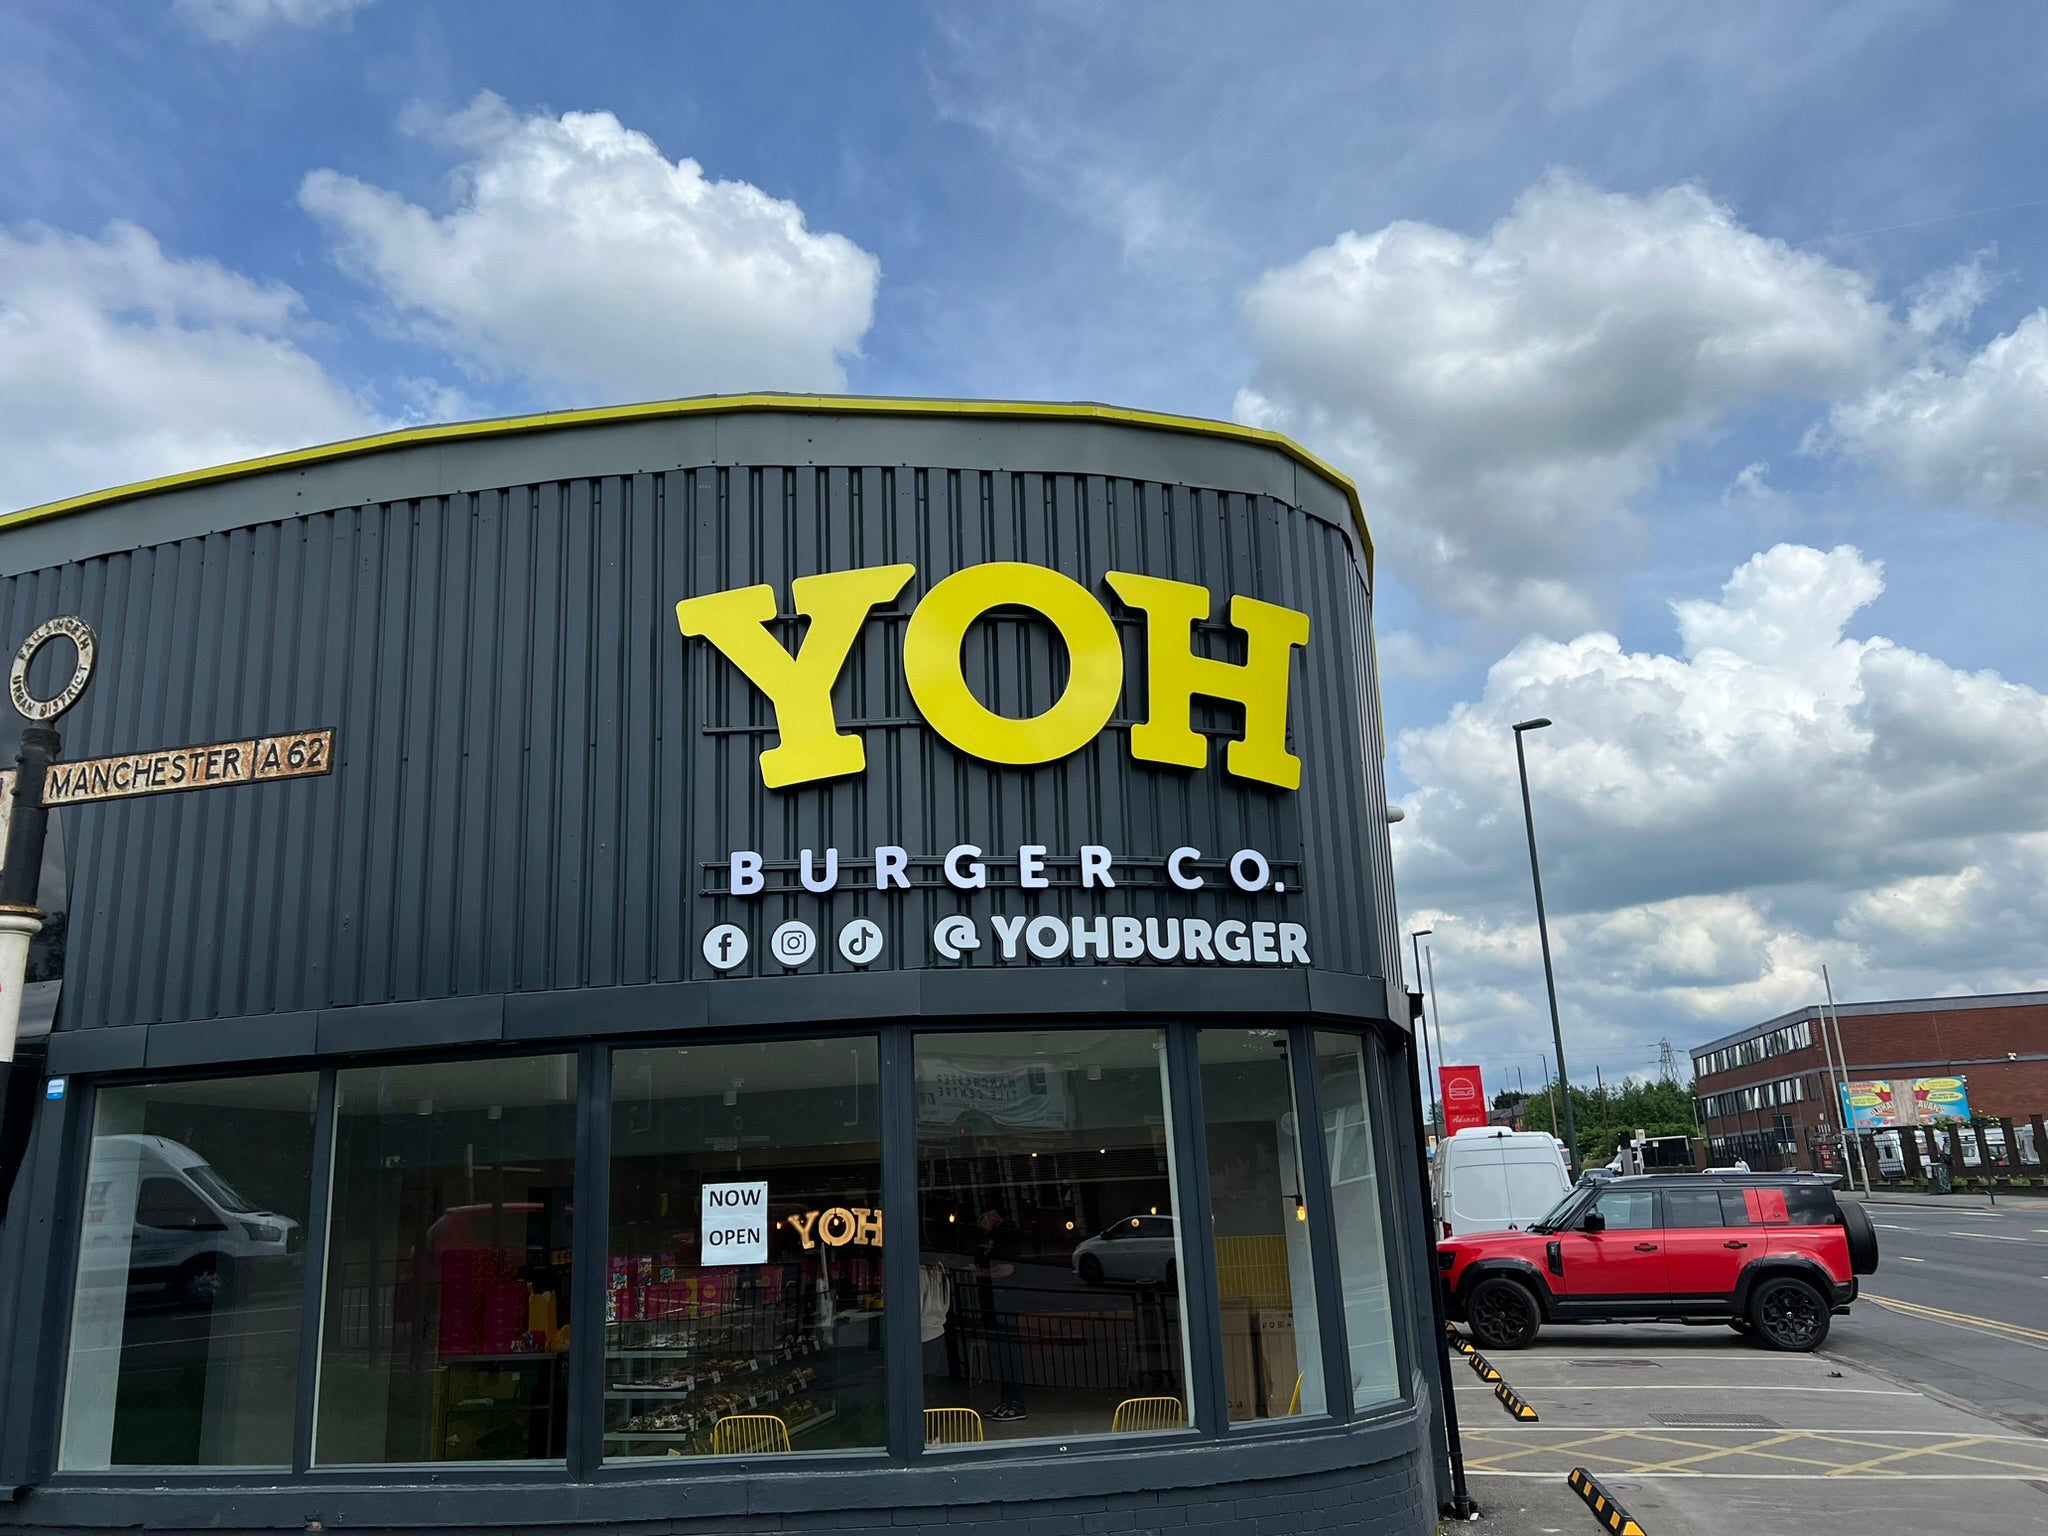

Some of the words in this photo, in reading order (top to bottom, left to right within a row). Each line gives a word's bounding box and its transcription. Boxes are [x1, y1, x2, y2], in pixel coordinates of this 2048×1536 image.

[12, 675, 36, 713] URBAN
[40, 663, 88, 718] DISTRICT
[676, 561, 1312, 790] YOH
[50, 748, 240, 799] MANCHESTER
[730, 844, 1116, 896] BURGER
[1167, 846, 1285, 893] CO.
[709, 1189, 762, 1207] NOW
[709, 1228, 760, 1247] OPEN
[788, 1207, 883, 1249] YOH
